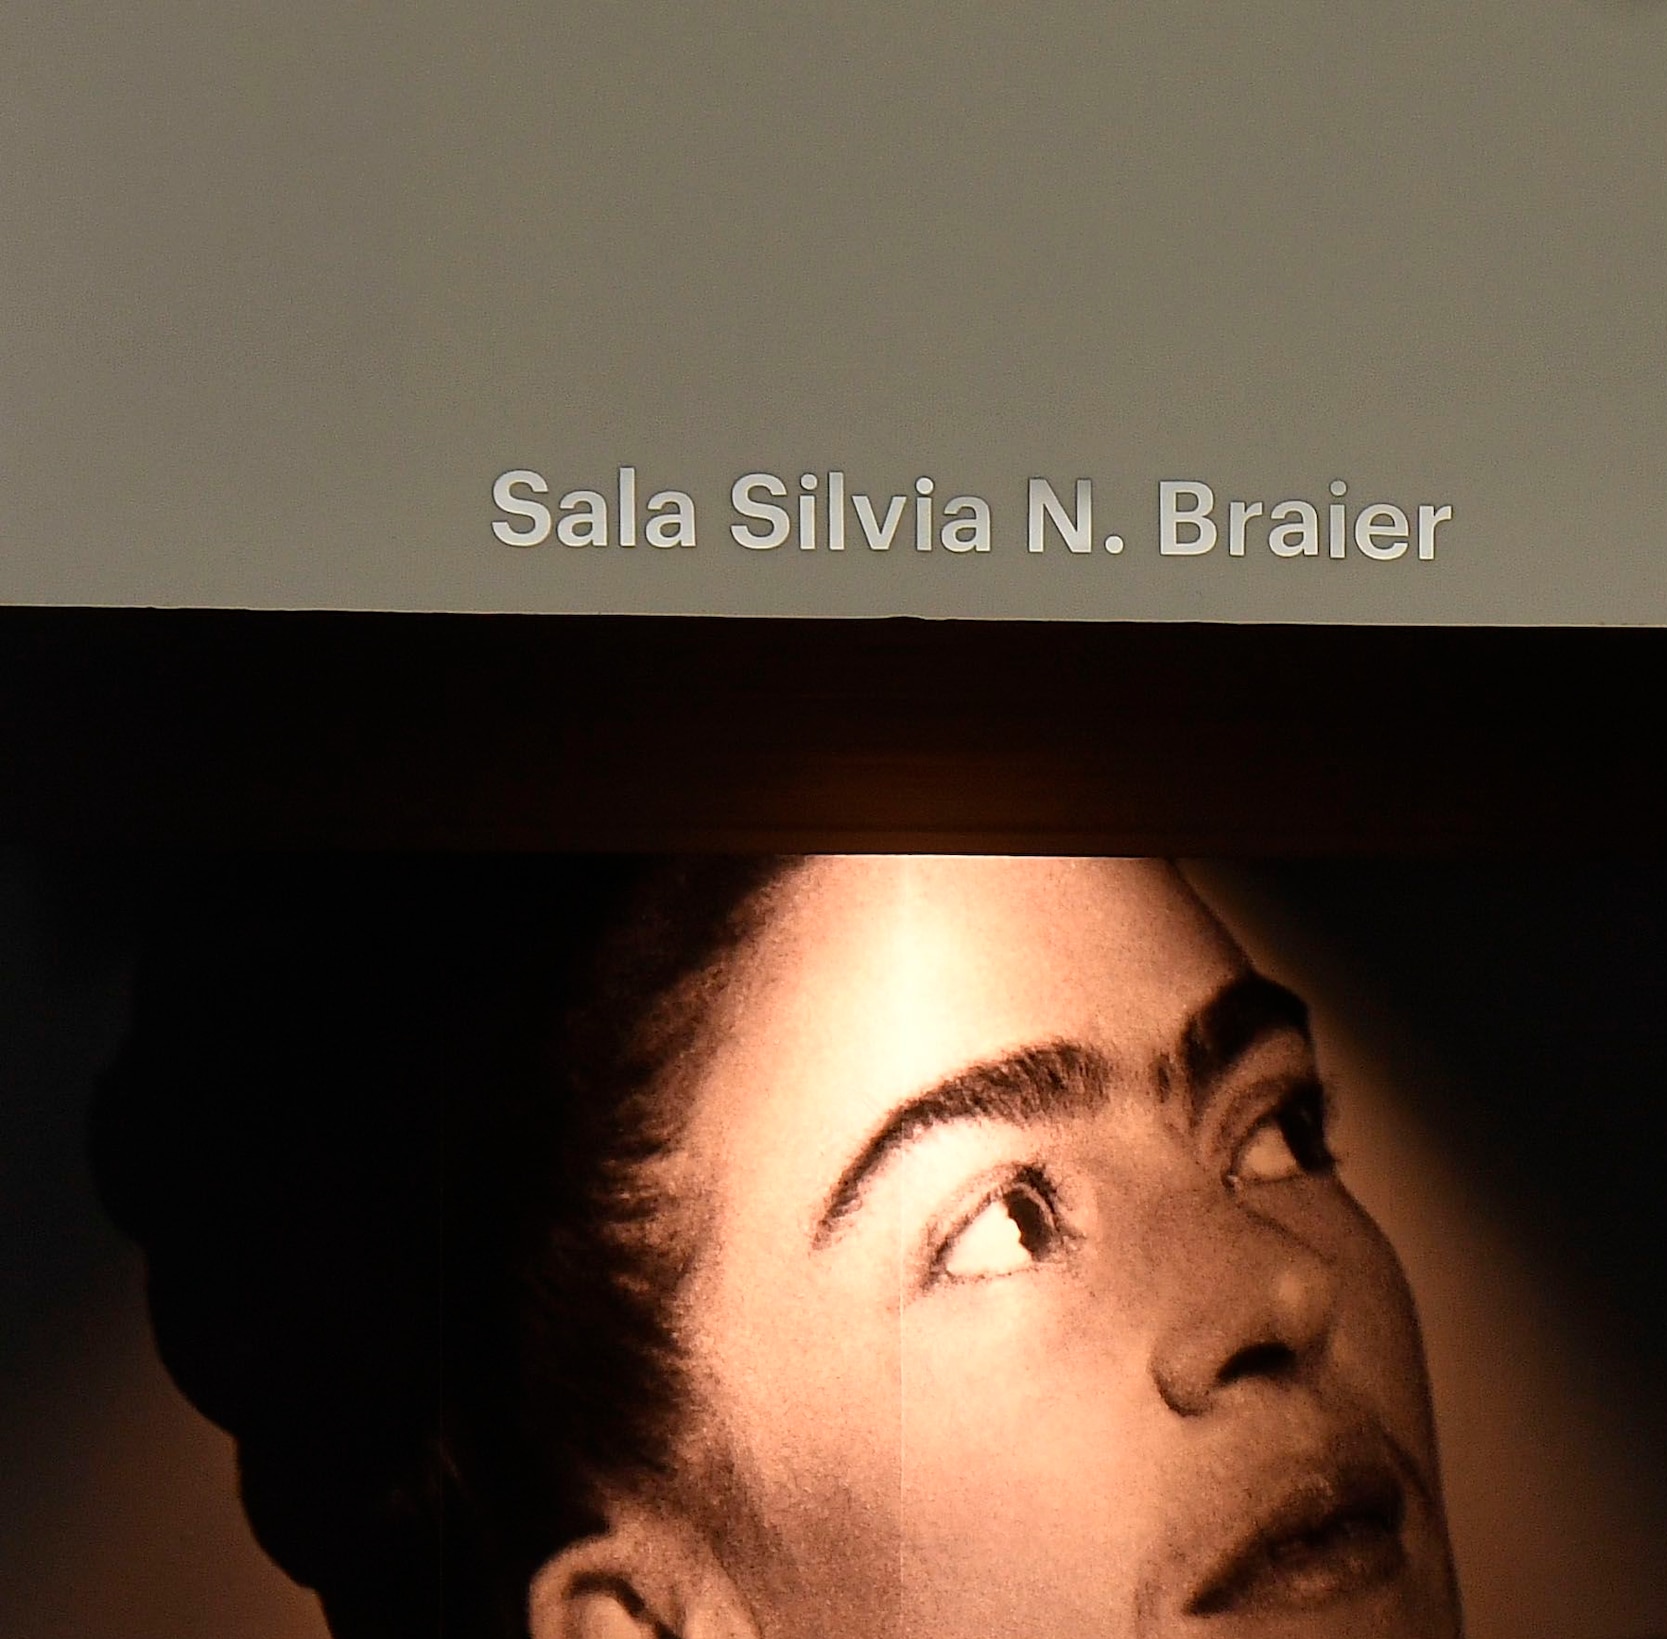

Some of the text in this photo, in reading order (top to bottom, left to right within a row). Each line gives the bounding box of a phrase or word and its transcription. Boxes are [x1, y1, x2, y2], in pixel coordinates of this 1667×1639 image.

[491, 466, 1454, 562] Sala Silvia N. Braier
